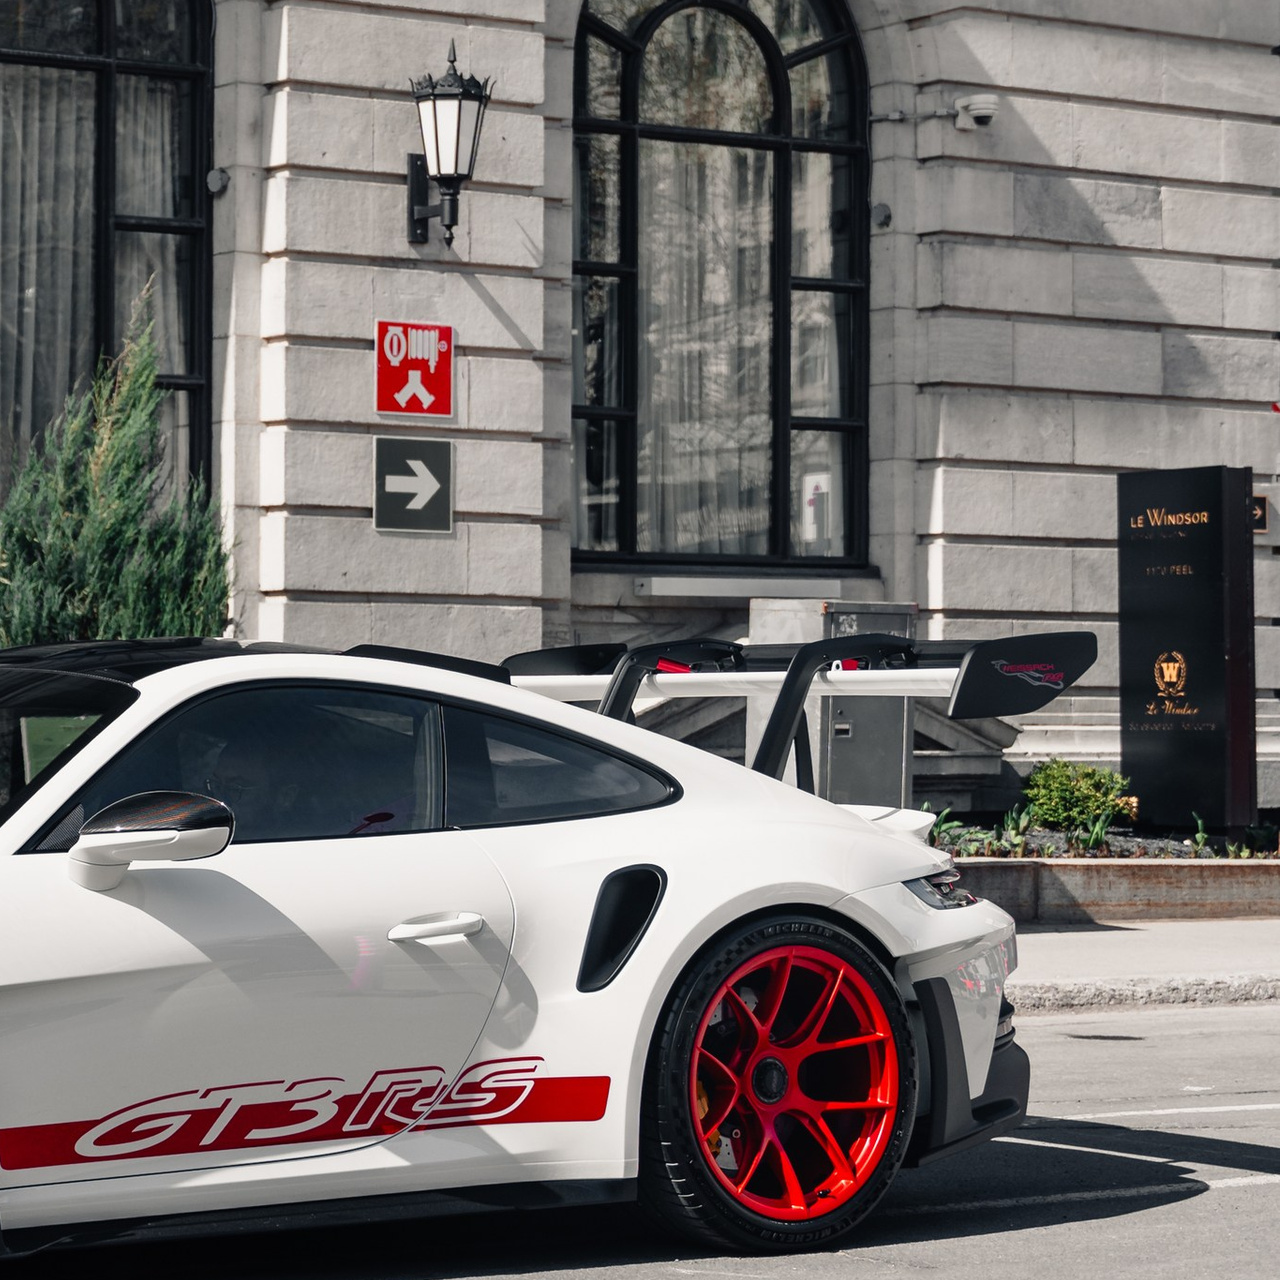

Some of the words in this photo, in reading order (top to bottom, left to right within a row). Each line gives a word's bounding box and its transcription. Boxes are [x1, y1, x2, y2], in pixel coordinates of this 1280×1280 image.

[1130, 515, 1144, 528] LE
[1169, 564, 1193, 576] PEEL
[1160, 662, 1180, 682] W
[763, 923, 833, 937] MICHELIN
